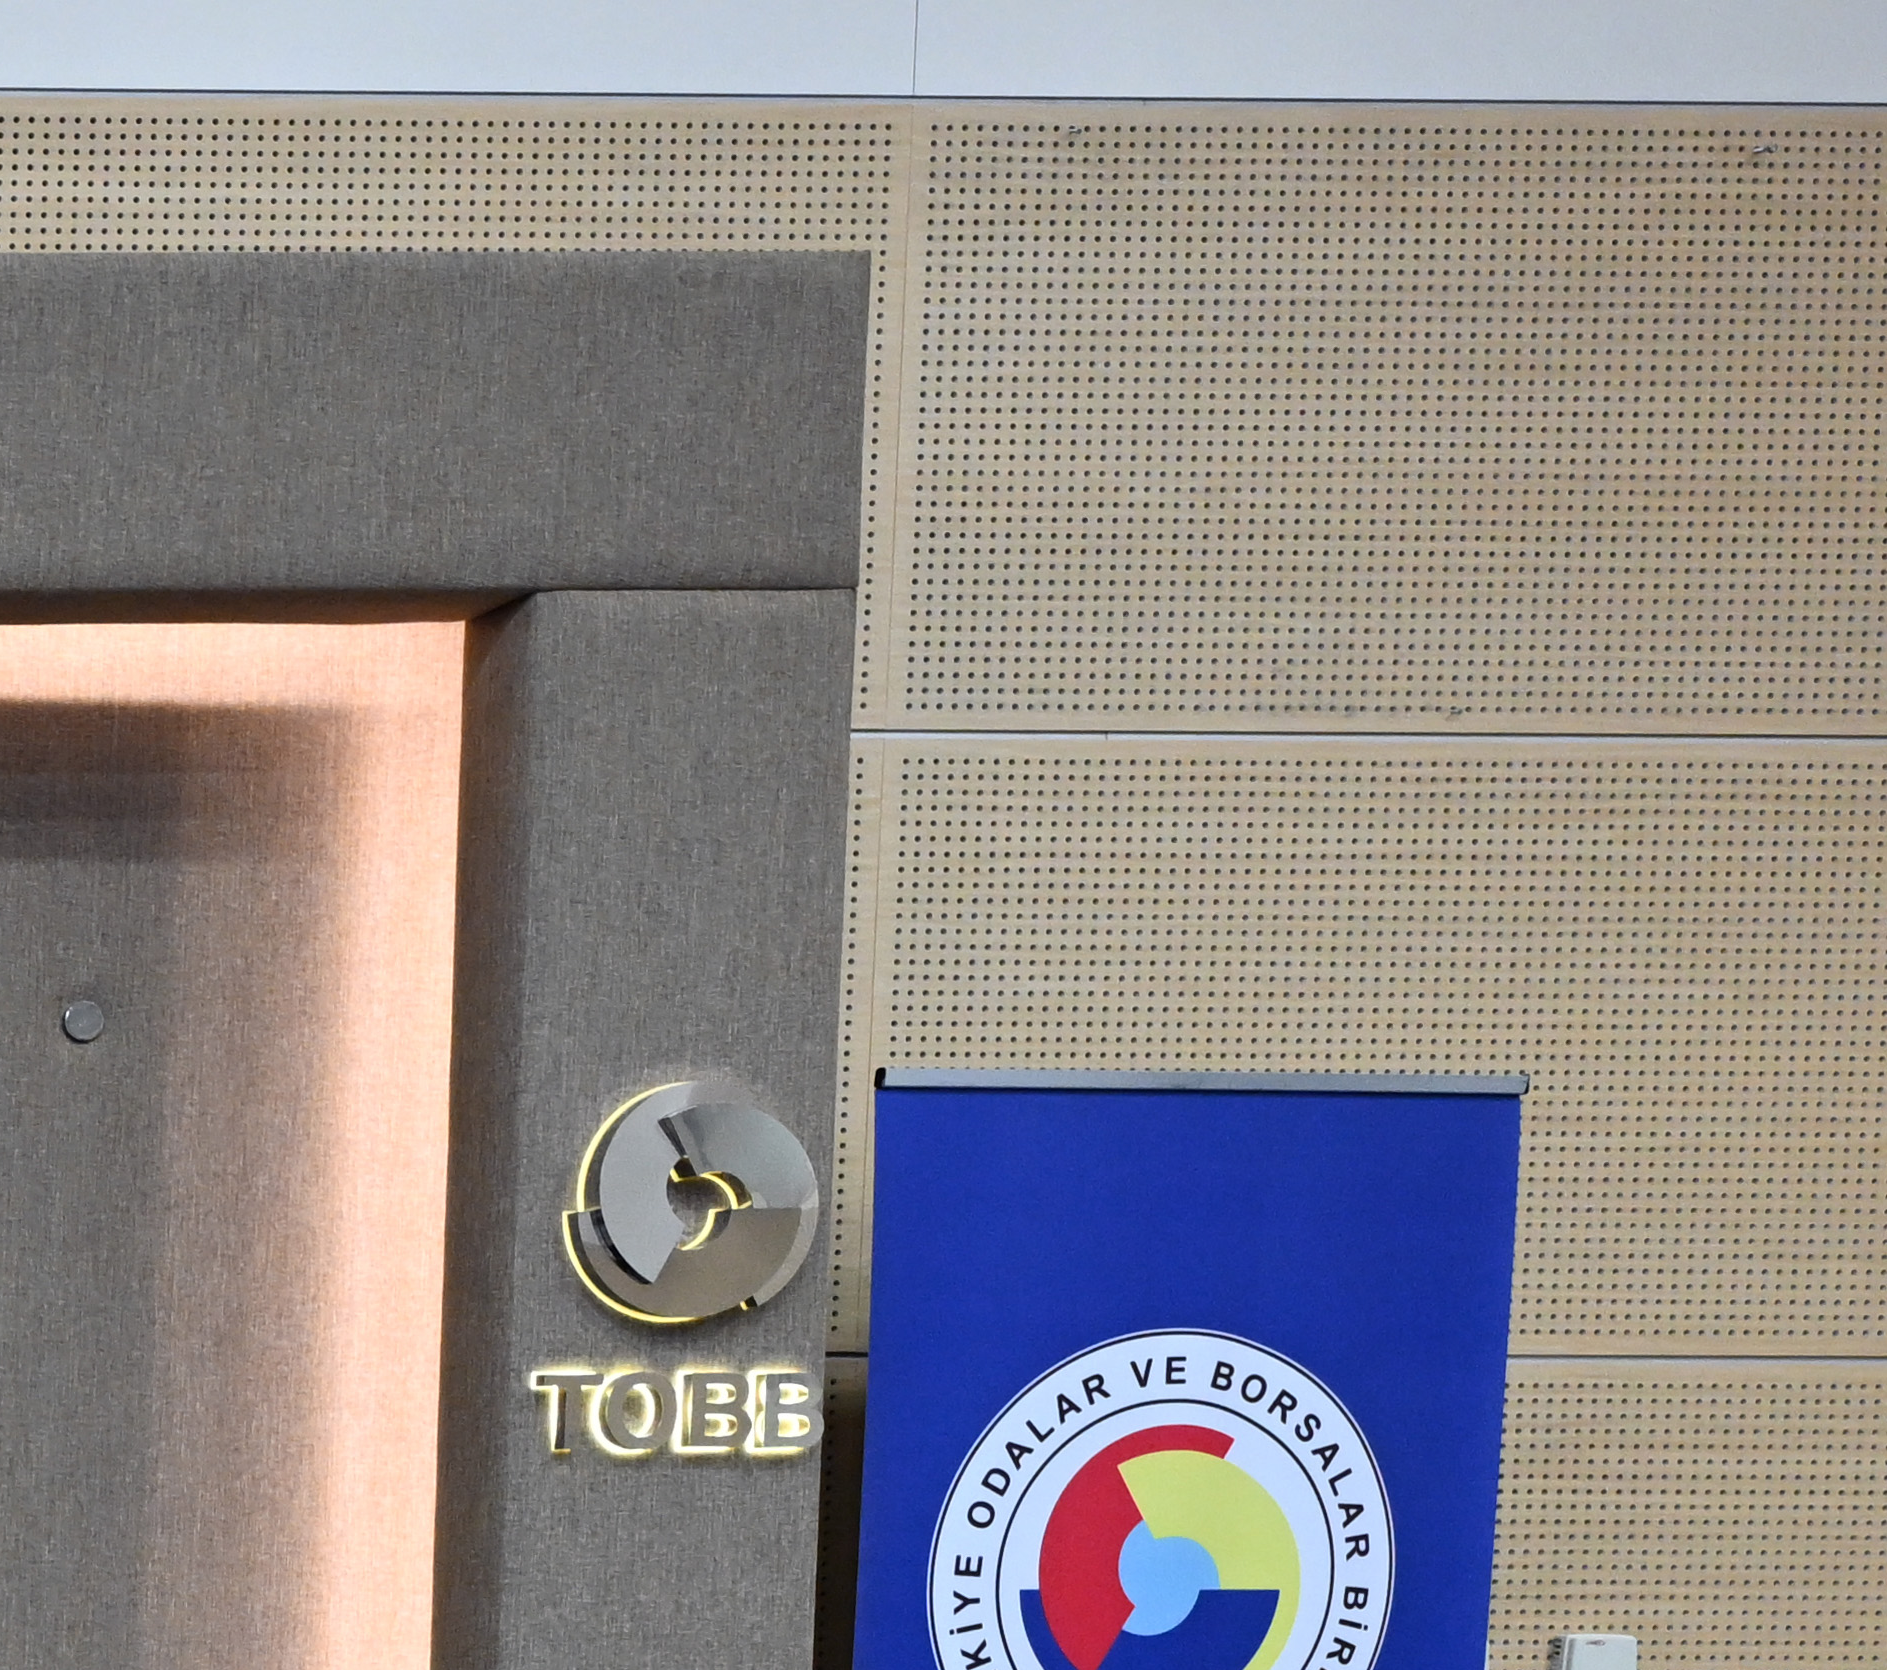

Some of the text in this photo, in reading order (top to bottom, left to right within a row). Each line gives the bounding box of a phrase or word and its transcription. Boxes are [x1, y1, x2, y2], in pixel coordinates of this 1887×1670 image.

[530, 1369, 825, 1454] TOBB
[967, 1373, 1111, 1529] ODALAR
[1130, 1356, 1187, 1388] VE
[1210, 1360, 1371, 1562] BORSALAR
